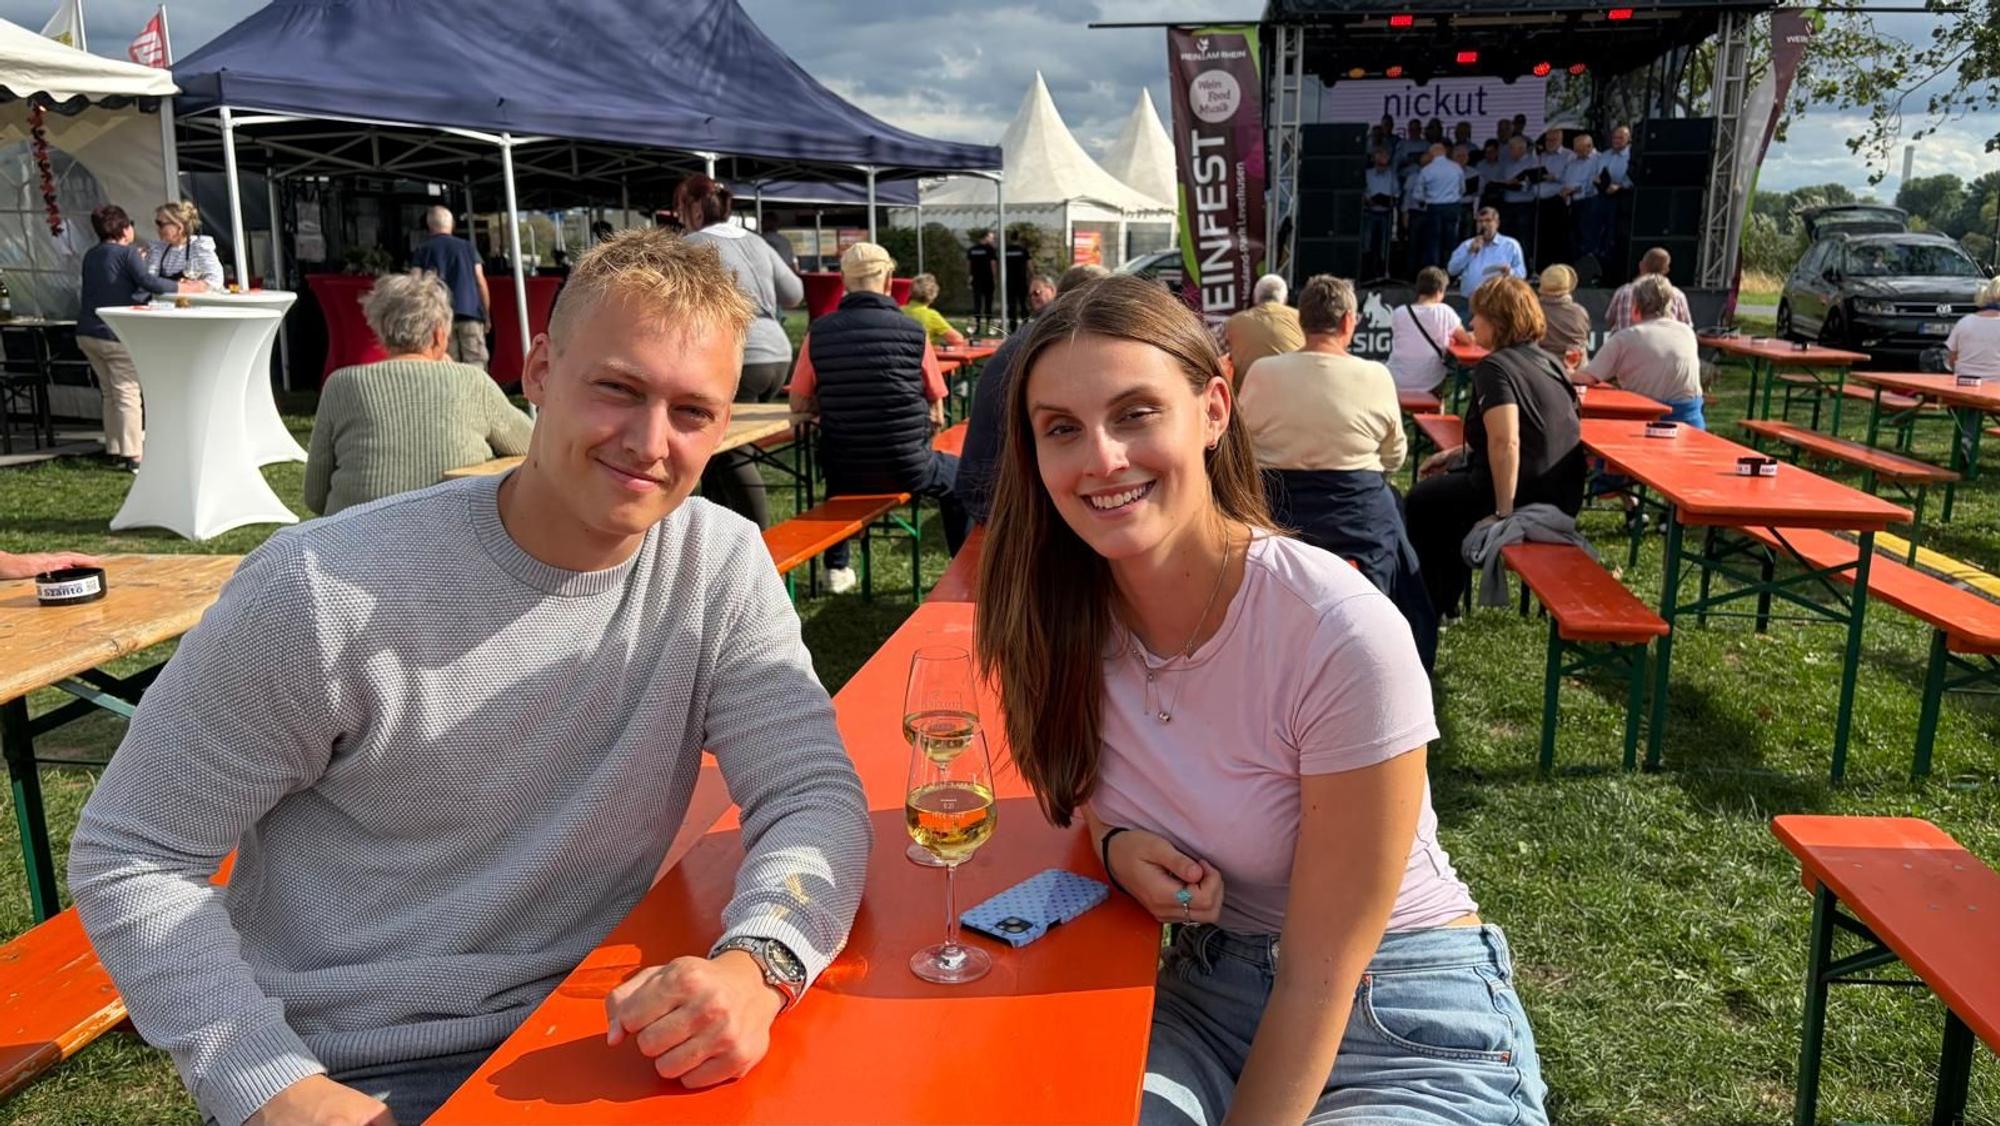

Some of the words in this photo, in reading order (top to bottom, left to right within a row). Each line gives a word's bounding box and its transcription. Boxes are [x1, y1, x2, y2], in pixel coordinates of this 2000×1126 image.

[1198, 80, 1222, 89] Wein
[1209, 89, 1231, 101] Food
[1384, 84, 1488, 117] nickut
[1200, 103, 1229, 114] Musik
